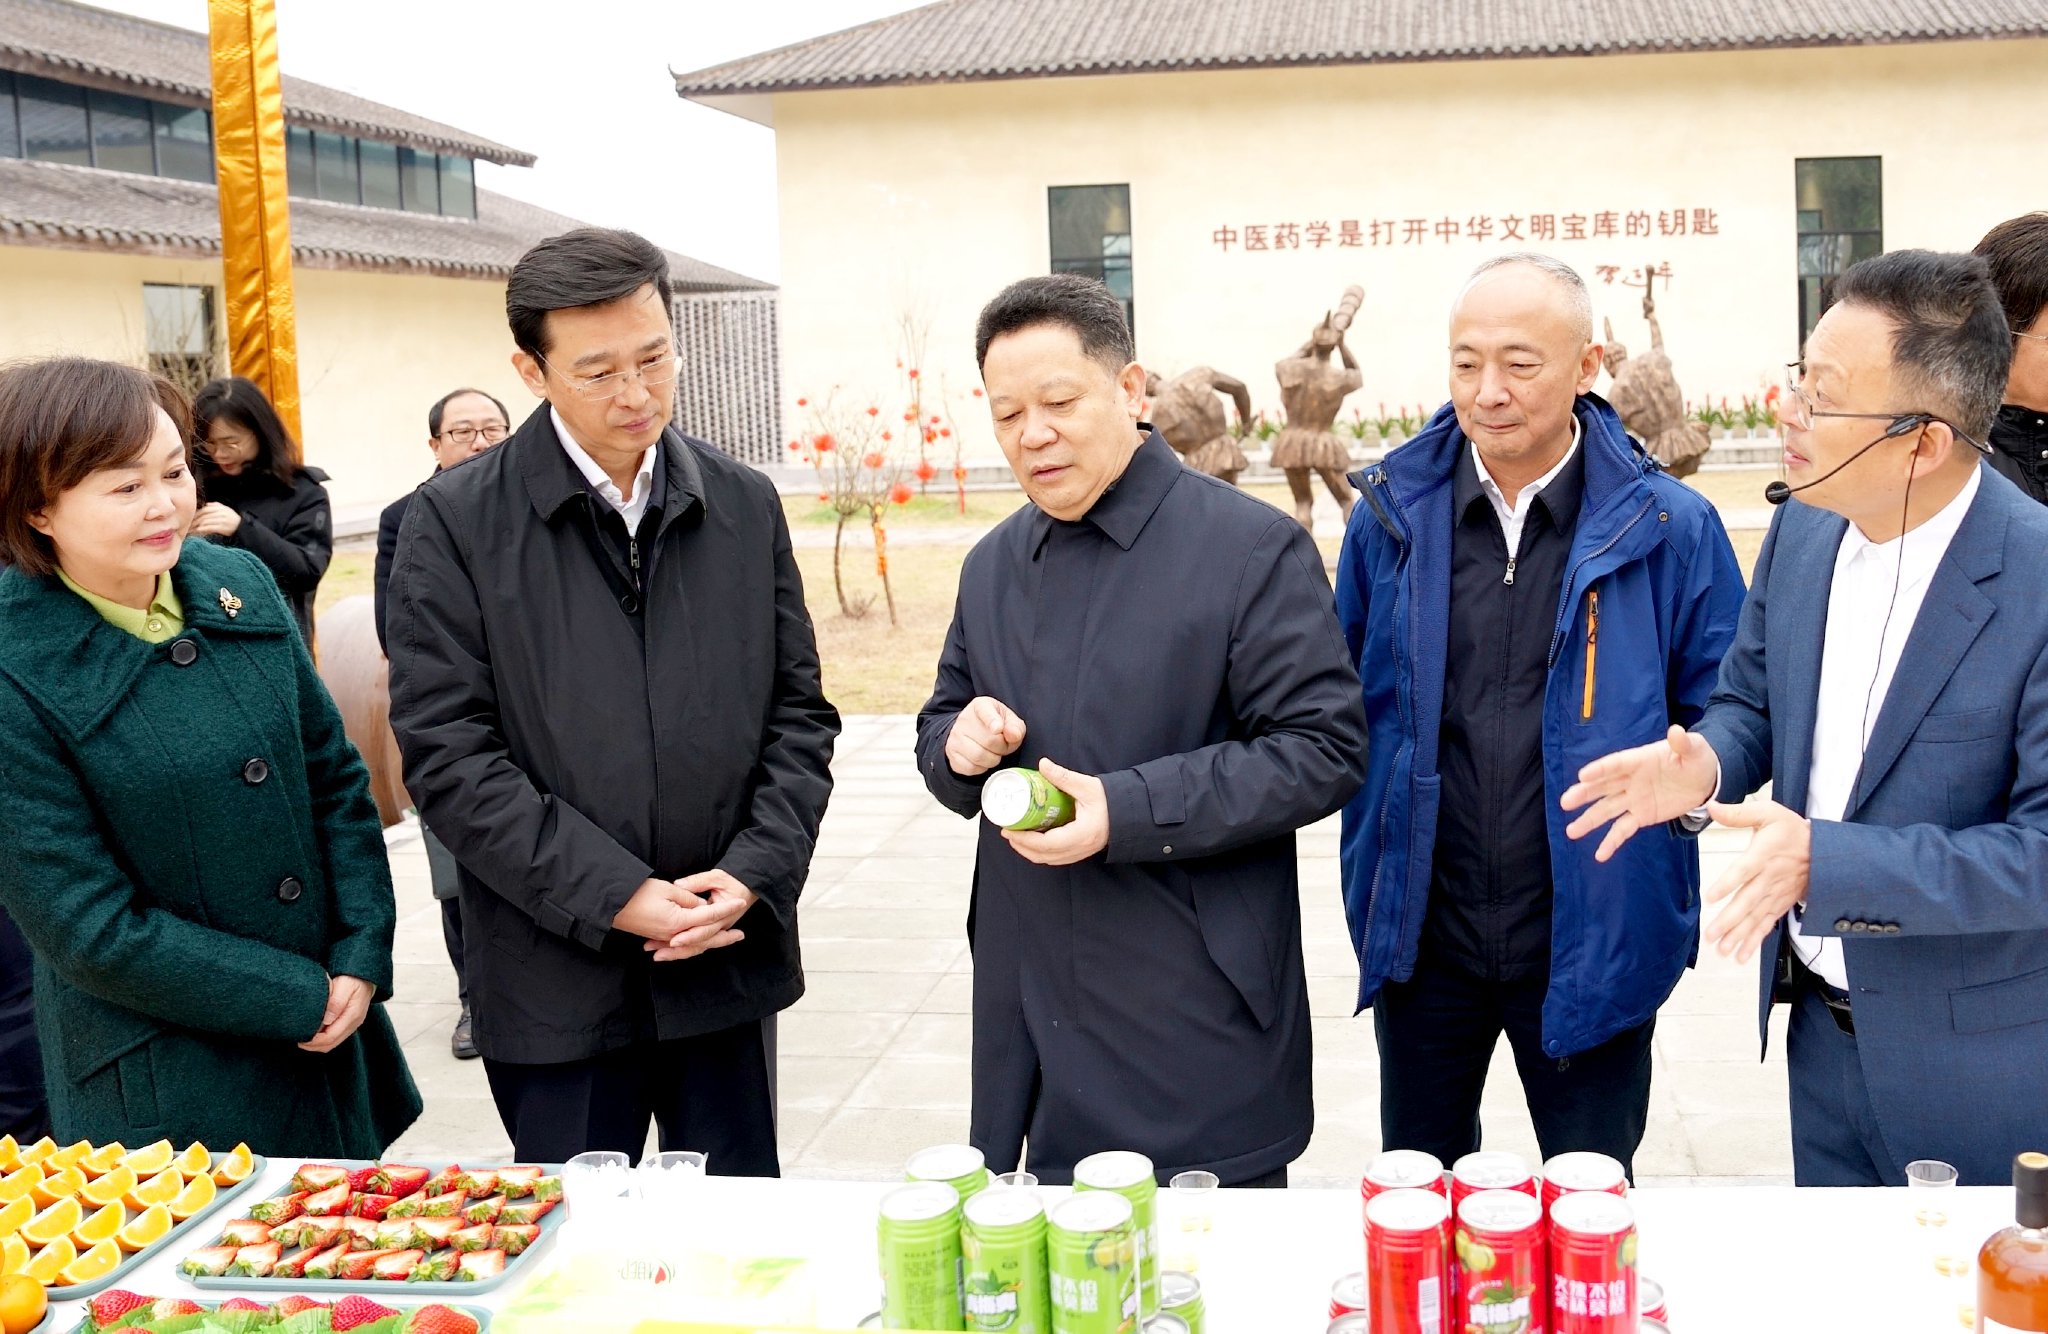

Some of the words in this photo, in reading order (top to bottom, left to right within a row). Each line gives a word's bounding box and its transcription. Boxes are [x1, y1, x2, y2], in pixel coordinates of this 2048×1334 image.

[1213, 208, 1719, 252] 中医药学是打开中华文明宝库的钥匙
